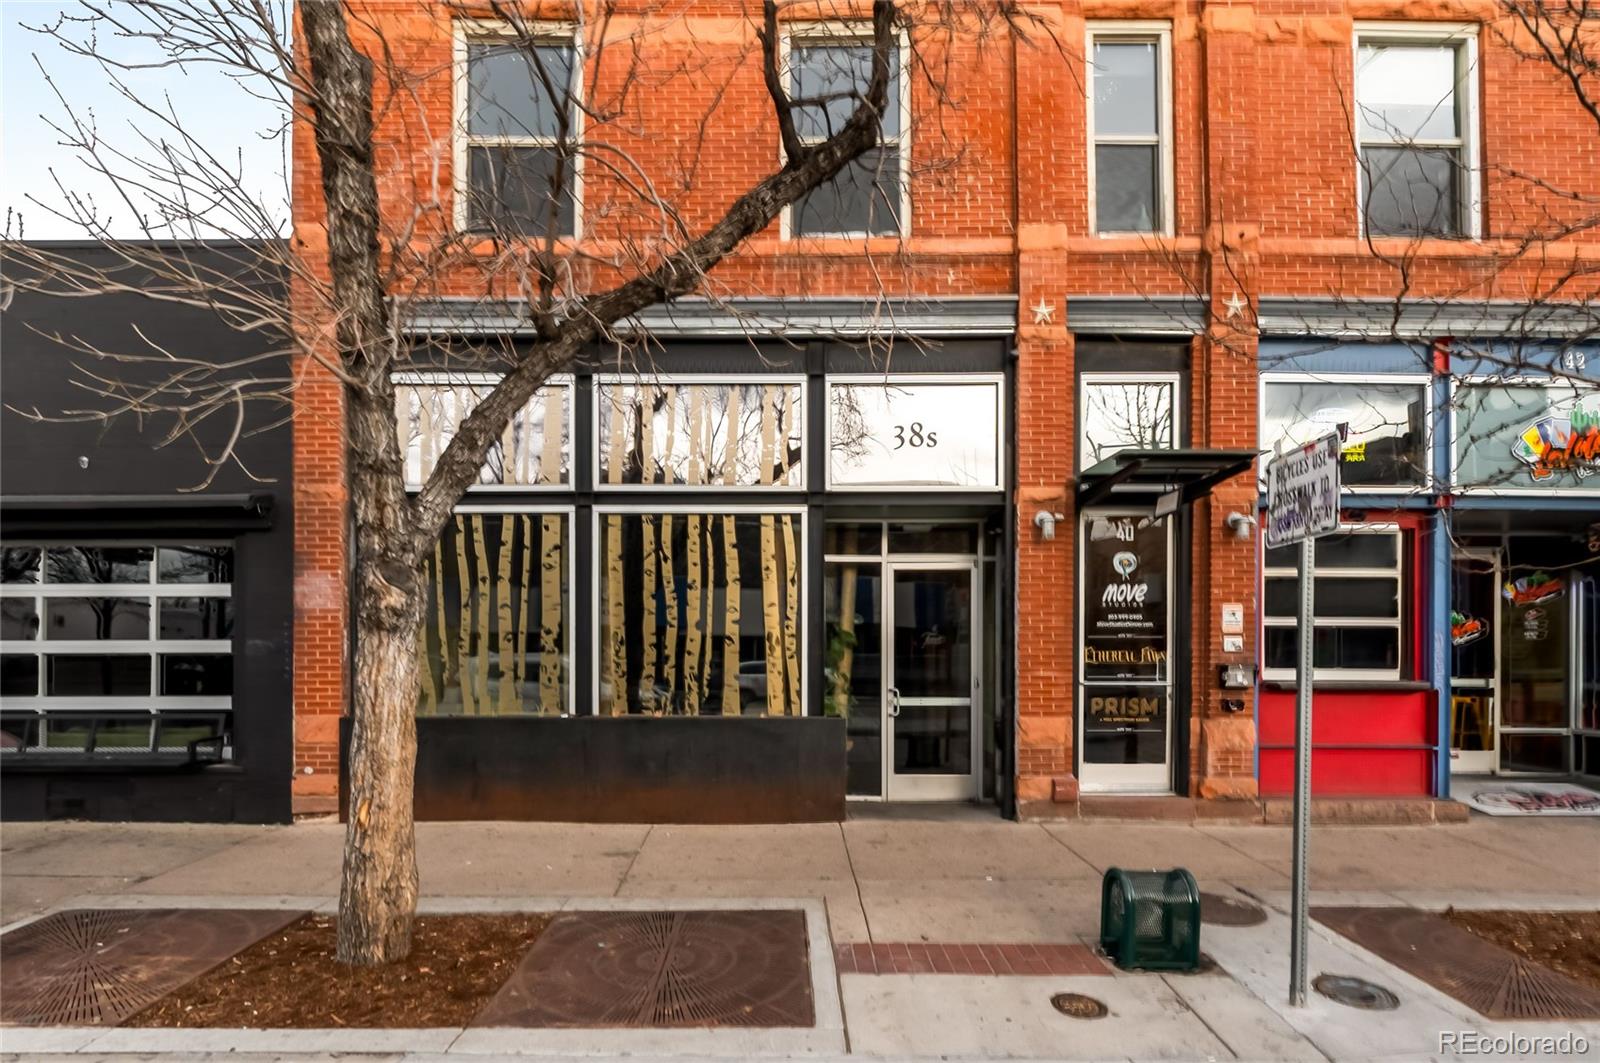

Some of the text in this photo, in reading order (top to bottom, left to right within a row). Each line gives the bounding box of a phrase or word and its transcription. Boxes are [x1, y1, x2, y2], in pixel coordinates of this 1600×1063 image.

[1564, 352, 1586, 369] 42
[893, 421, 938, 450] 38s
[1312, 449, 1328, 470] USE
[1116, 521, 1134, 541] 40
[1090, 697, 1159, 716] PRISM
